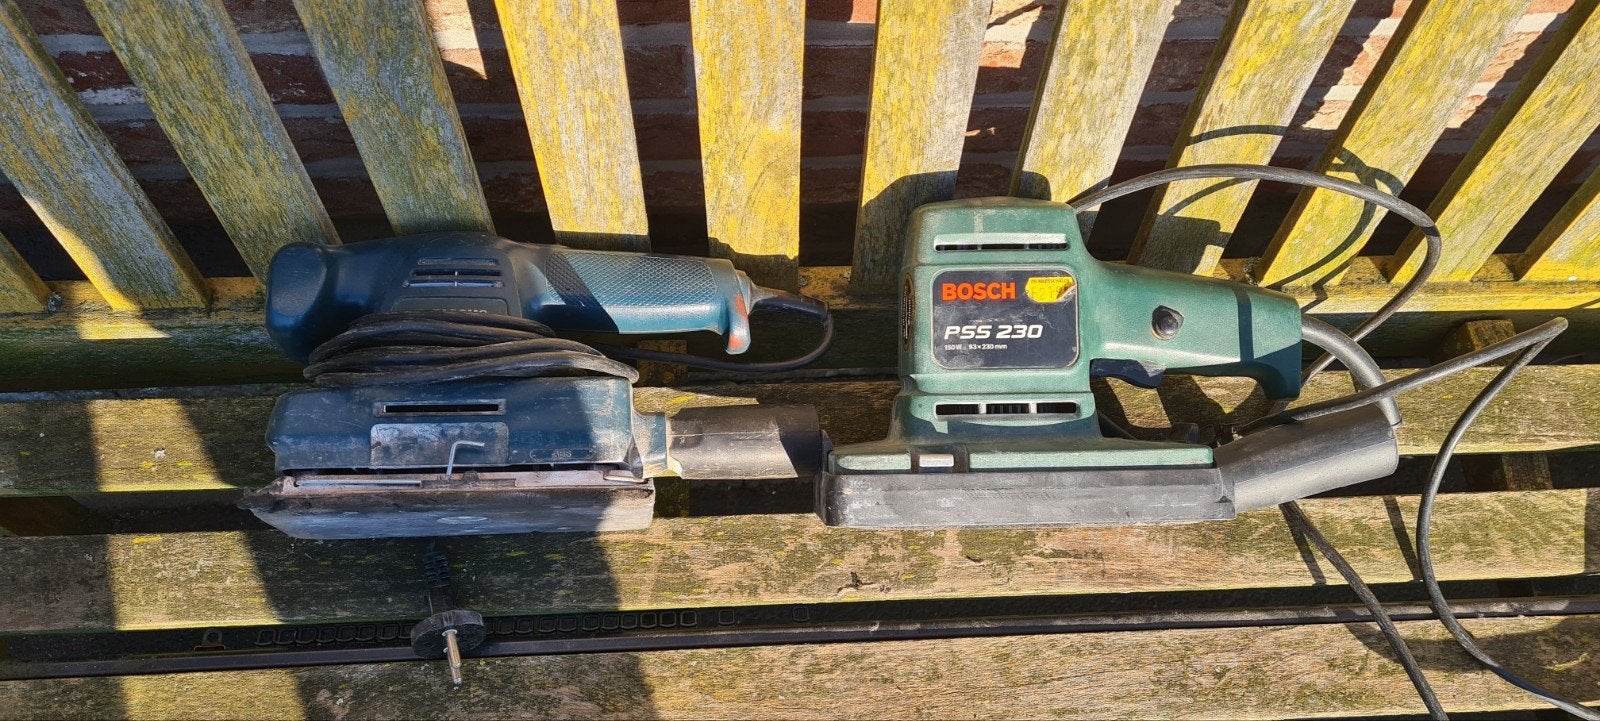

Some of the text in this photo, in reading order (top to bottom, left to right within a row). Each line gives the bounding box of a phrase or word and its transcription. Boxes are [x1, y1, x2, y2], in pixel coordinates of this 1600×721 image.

[942, 282, 1016, 300] BOSCH
[944, 324, 1044, 339] PSS 230
